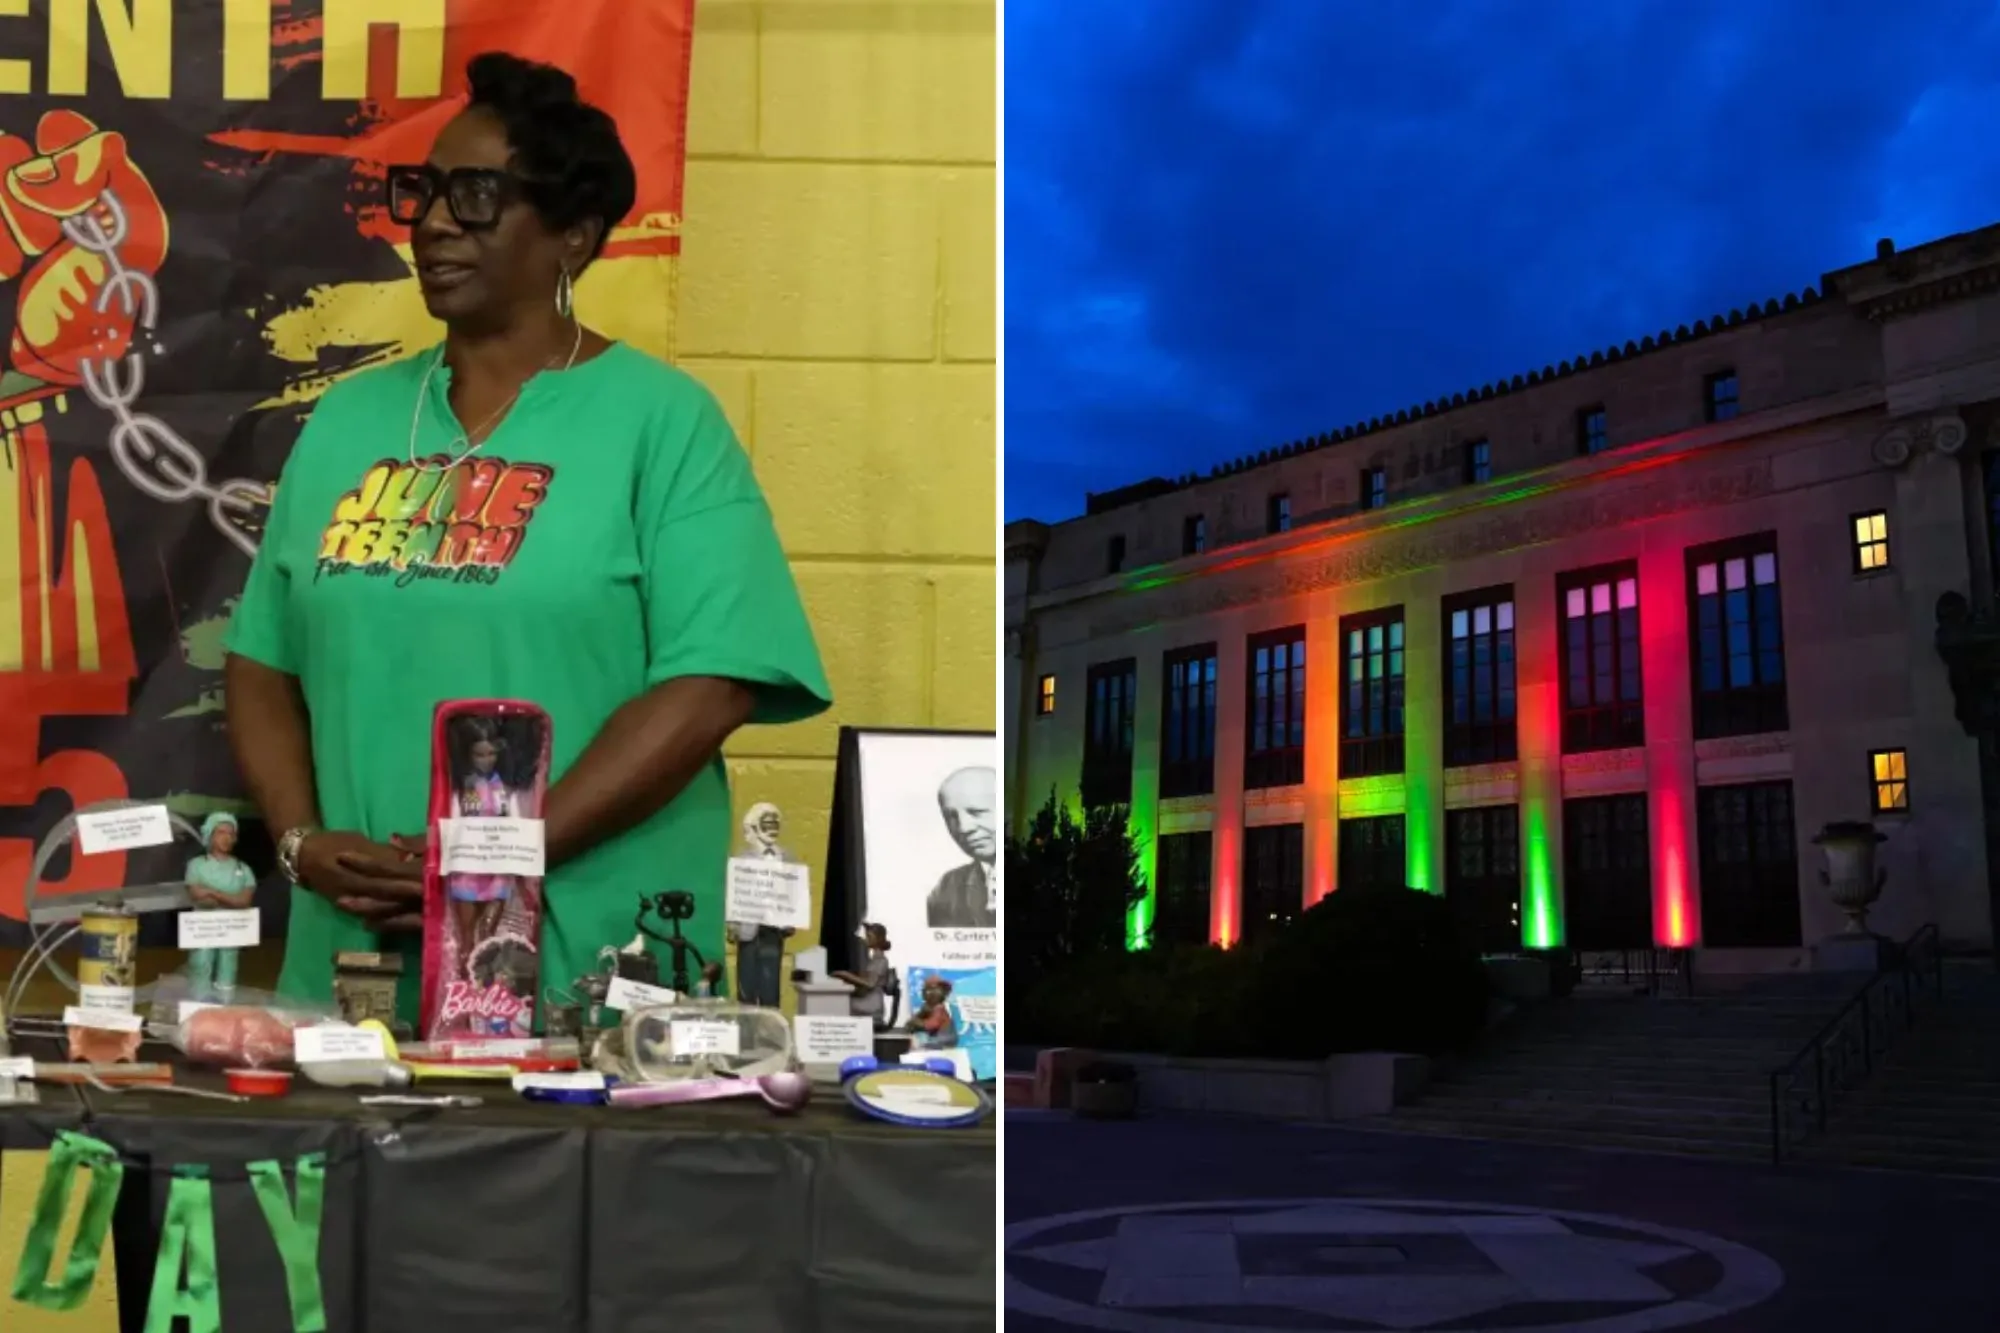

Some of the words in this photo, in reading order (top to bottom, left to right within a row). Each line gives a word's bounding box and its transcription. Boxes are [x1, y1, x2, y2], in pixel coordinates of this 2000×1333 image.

[334, 457, 551, 530] JUNE
[318, 523, 522, 568] TEENTH
[442, 981, 519, 1021] Barbie
[13, 1128, 327, 1333] DAY
